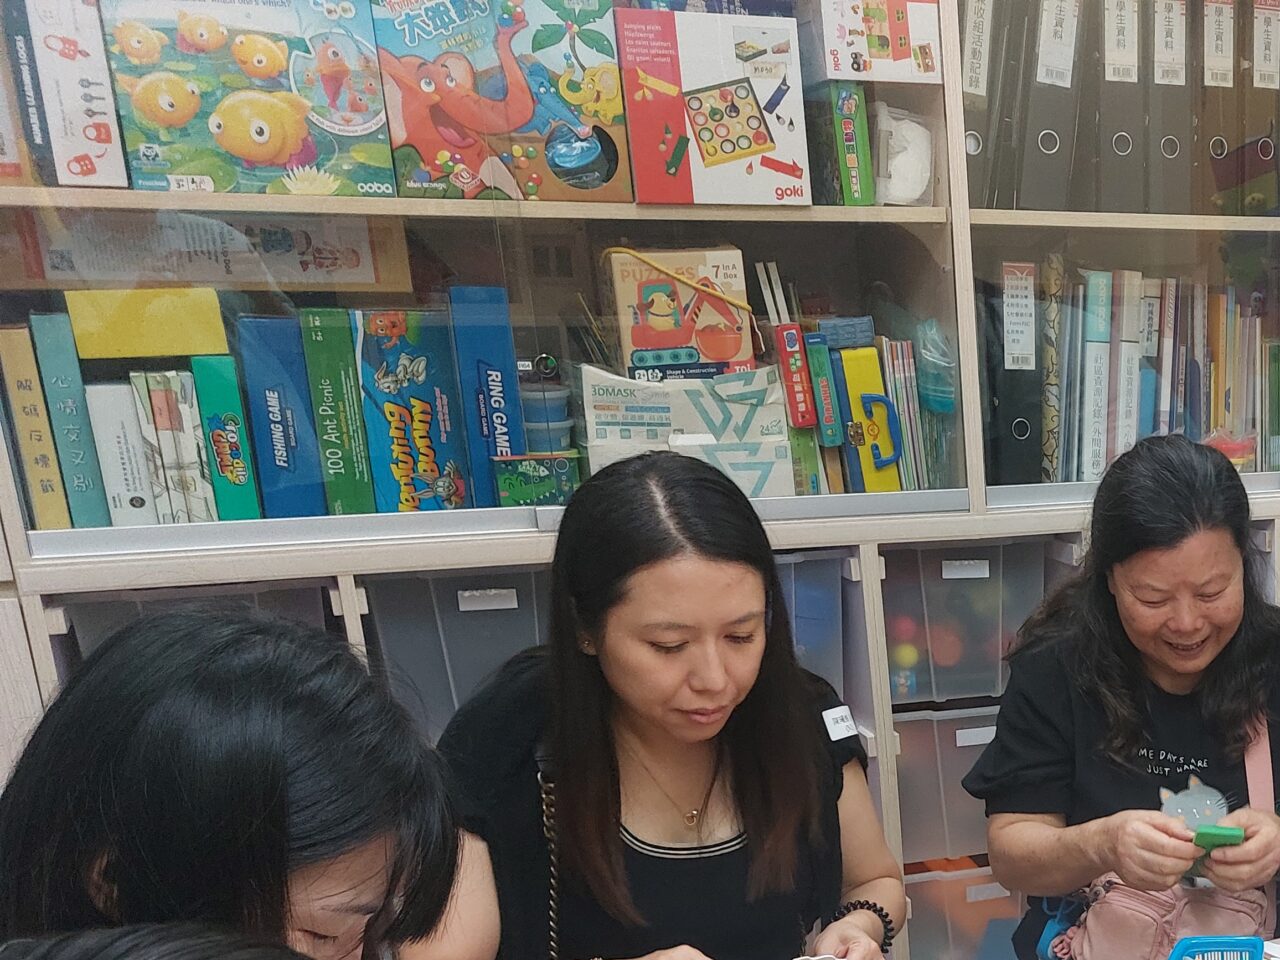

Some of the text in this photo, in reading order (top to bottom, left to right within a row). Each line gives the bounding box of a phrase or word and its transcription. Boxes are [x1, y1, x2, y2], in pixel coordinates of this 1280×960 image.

[1164, 2, 1174, 51] 學生資料
[1214, 6, 1224, 54] 學生資料
[1263, 16, 1272, 64] 學生資料
[830, 49, 842, 71] goki
[775, 185, 803, 200] goki
[711, 265, 720, 279] 7
[591, 385, 637, 398] 3DMASK
[265, 390, 289, 467] FISHING GAME
[319, 378, 345, 475] 100 Ant Picnic
[479, 394, 489, 436] BOARD GAME
[486, 370, 511, 457] RING GAME
[1138, 747, 1209, 768] ME DAYS ARE
[1146, 764, 1171, 777] JUST
